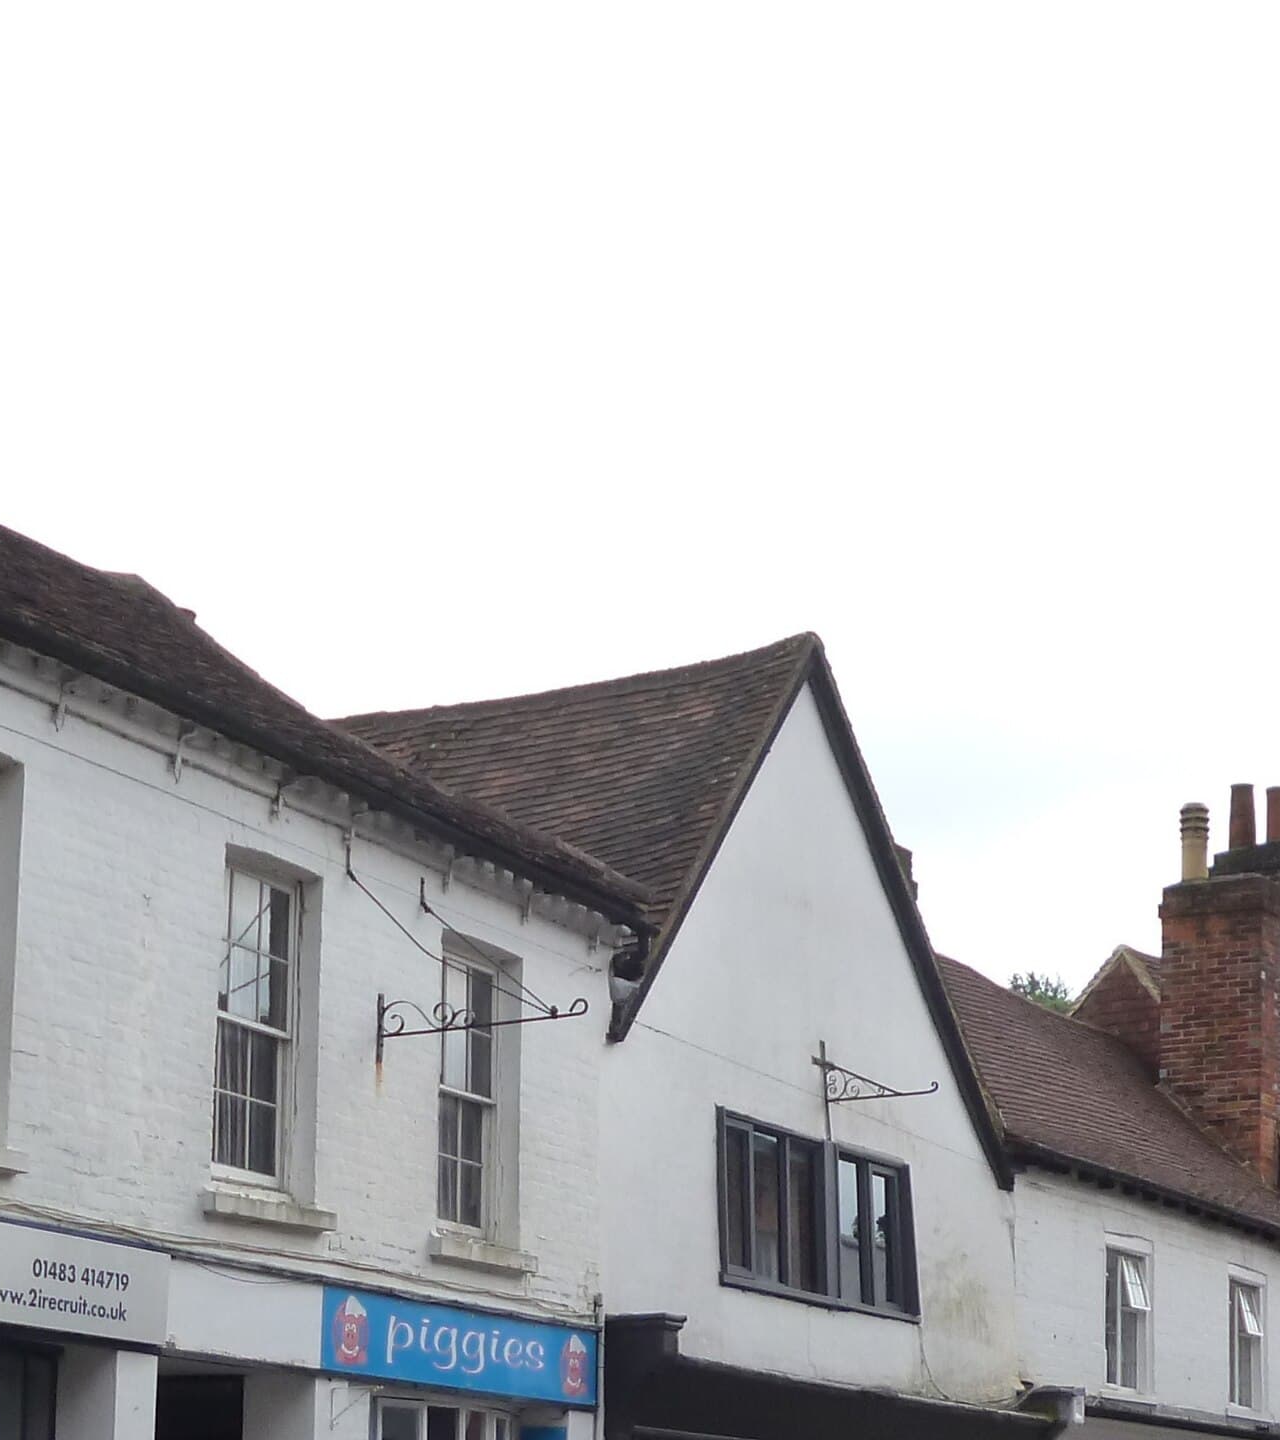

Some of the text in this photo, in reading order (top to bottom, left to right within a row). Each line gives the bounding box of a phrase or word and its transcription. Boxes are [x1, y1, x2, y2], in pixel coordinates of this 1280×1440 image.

[32, 1258, 130, 1292] 01483 414719
[386, 1315, 545, 1374] piggies
